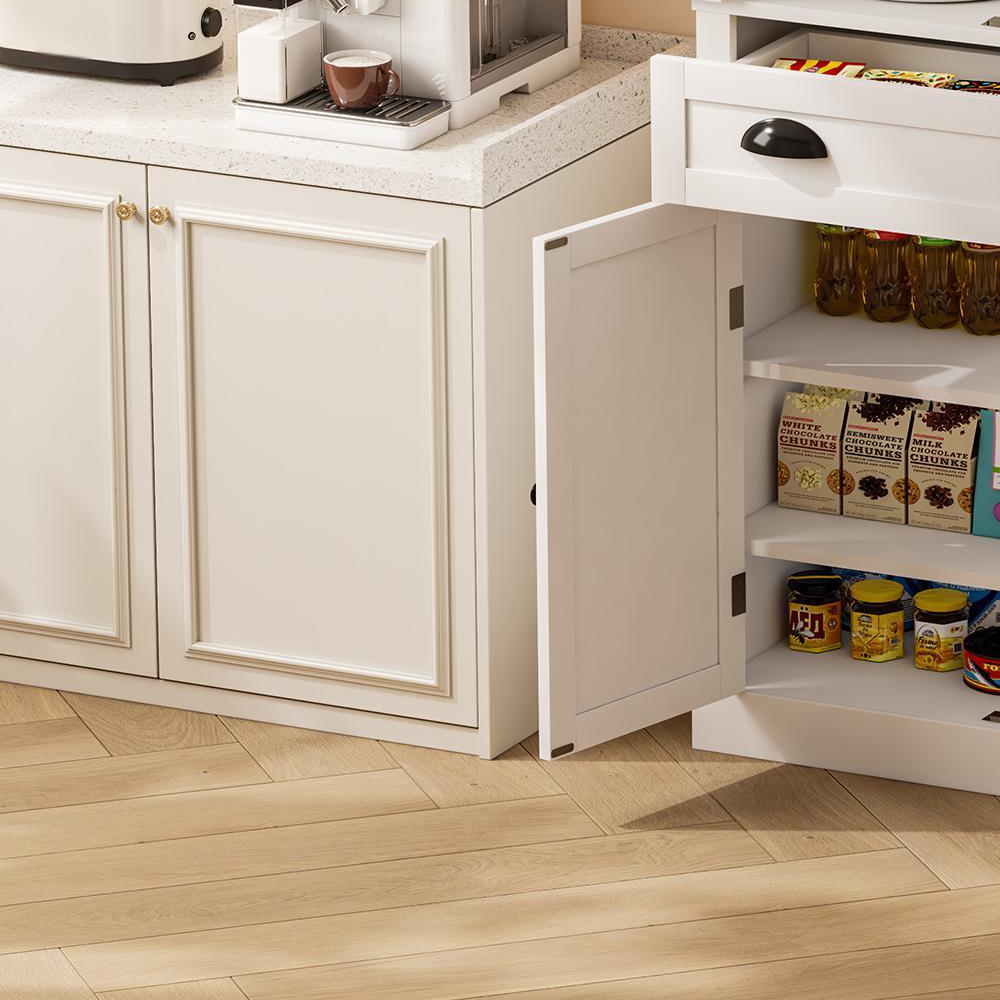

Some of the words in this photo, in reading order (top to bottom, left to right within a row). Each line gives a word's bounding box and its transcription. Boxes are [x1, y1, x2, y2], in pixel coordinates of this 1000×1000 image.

[782, 420, 822, 432] WHITE
[780, 428, 837, 441] CHOCOLATE
[846, 430, 904, 443] SEMISWEET
[780, 435, 837, 450] CHUNKS
[845, 437, 903, 450] CHOCOLATE
[912, 438, 943, 449] MILK
[844, 444, 902, 459] CHUNKS
[910, 446, 969, 460] CHOCOLATE
[910, 454, 968, 468] CHUNKS
